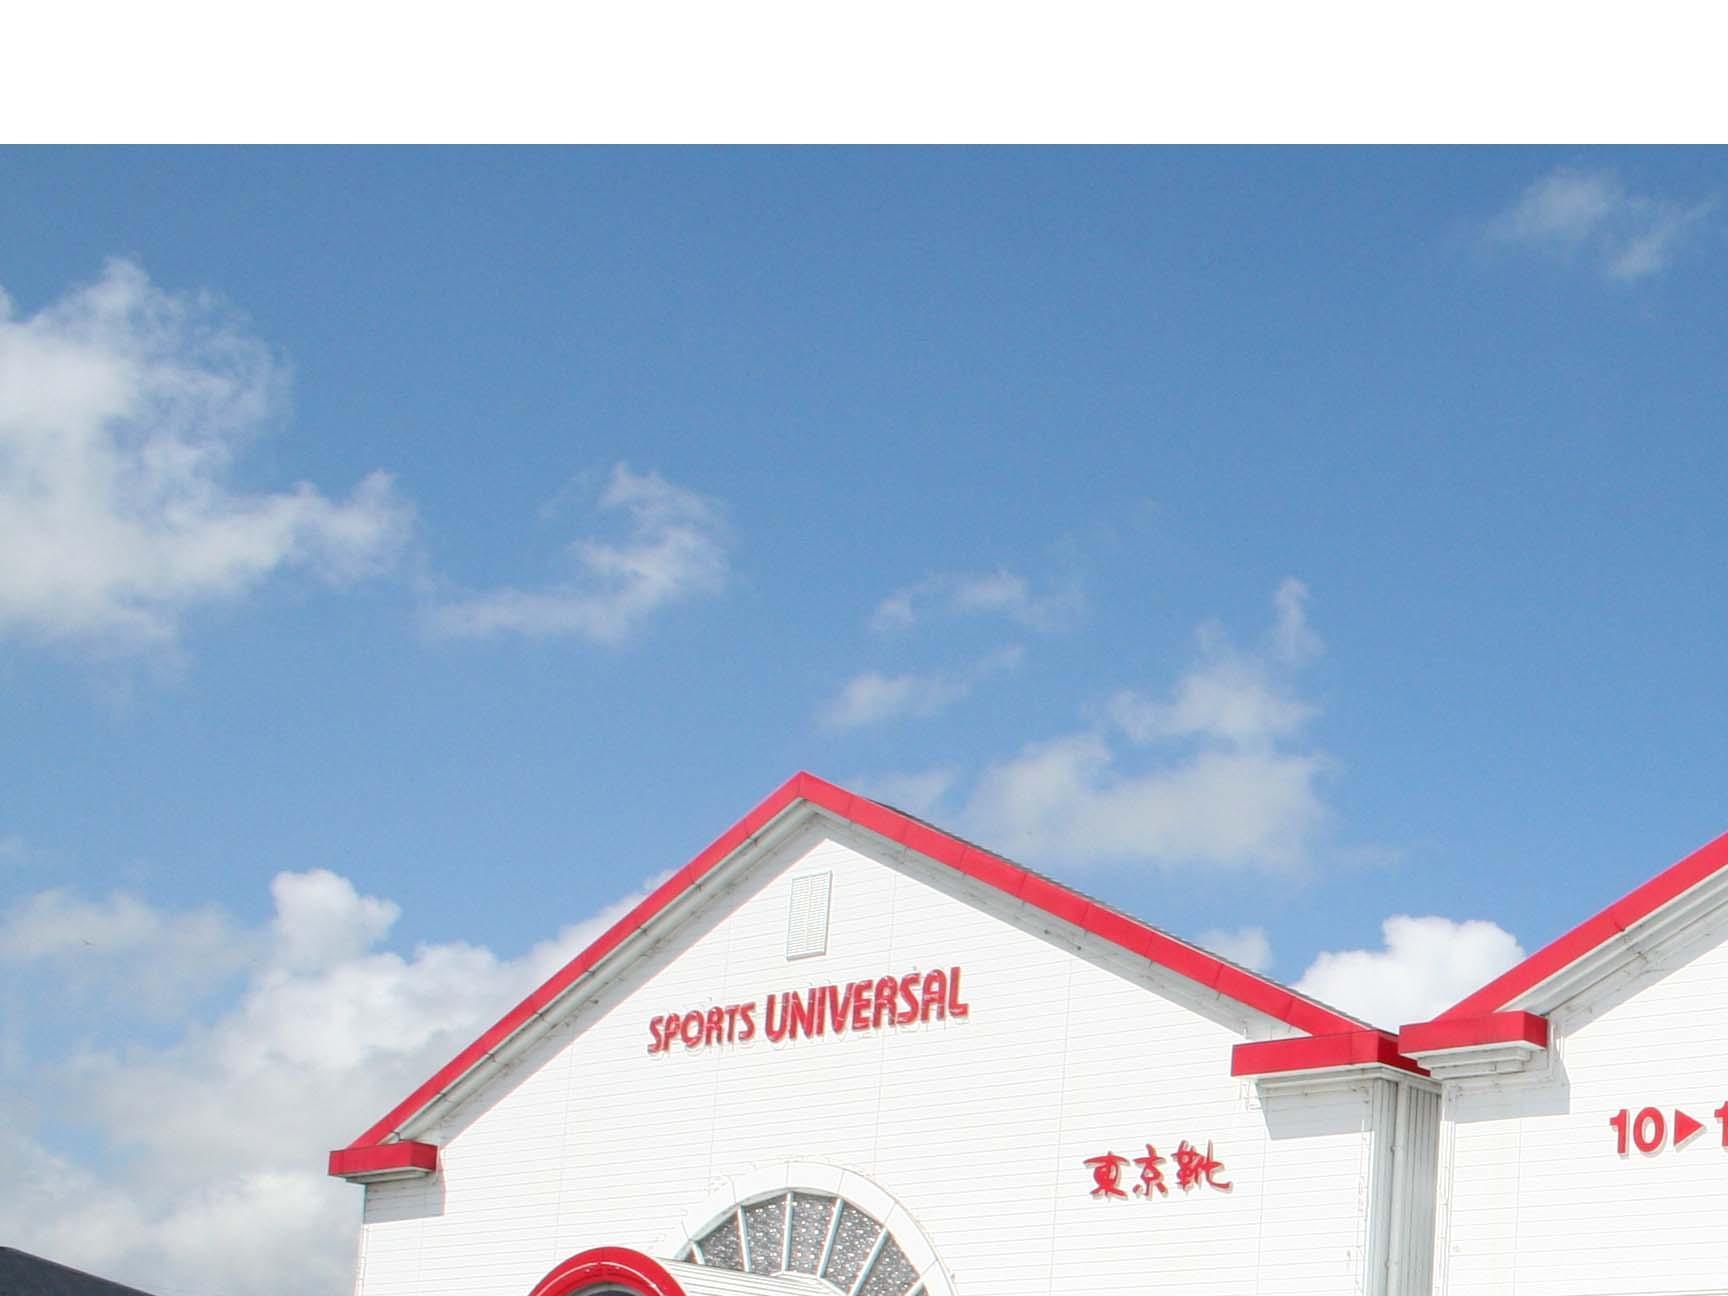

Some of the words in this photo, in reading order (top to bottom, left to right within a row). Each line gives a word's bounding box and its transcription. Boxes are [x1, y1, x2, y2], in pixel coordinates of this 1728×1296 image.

[648, 1004, 756, 1054] SPORTS
[764, 966, 969, 1042] UNIVERSAL
[1084, 1140, 1232, 1198] 東京靴
